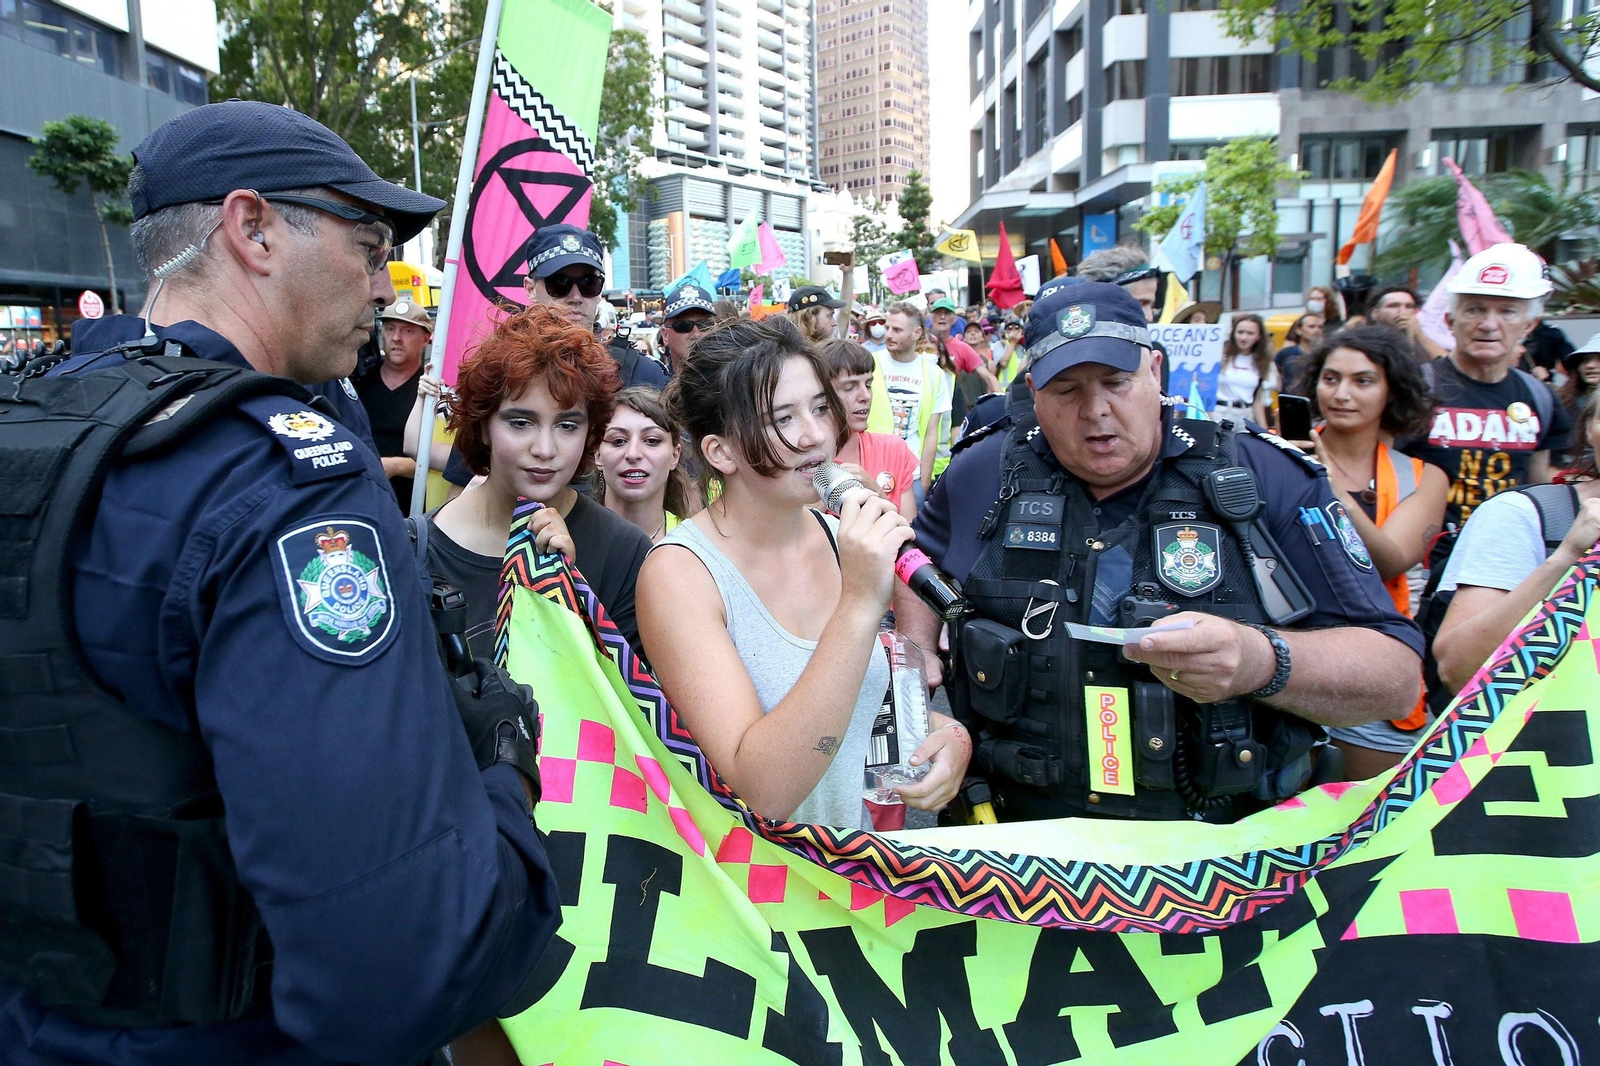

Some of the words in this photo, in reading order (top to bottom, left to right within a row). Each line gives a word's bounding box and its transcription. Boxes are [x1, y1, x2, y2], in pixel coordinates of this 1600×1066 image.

[294, 441, 354, 460] QUEENSLAND
[312, 453, 348, 469] POLICE
[1458, 449, 1512, 480] NO
[1018, 501, 1054, 516] TCS
[1169, 511, 1197, 519] TCS
[1026, 530, 1056, 543] 8384
[321, 564, 367, 598] QUEENSLAND
[333, 597, 367, 613] POLICE
[1099, 692, 1119, 787] POLICE
